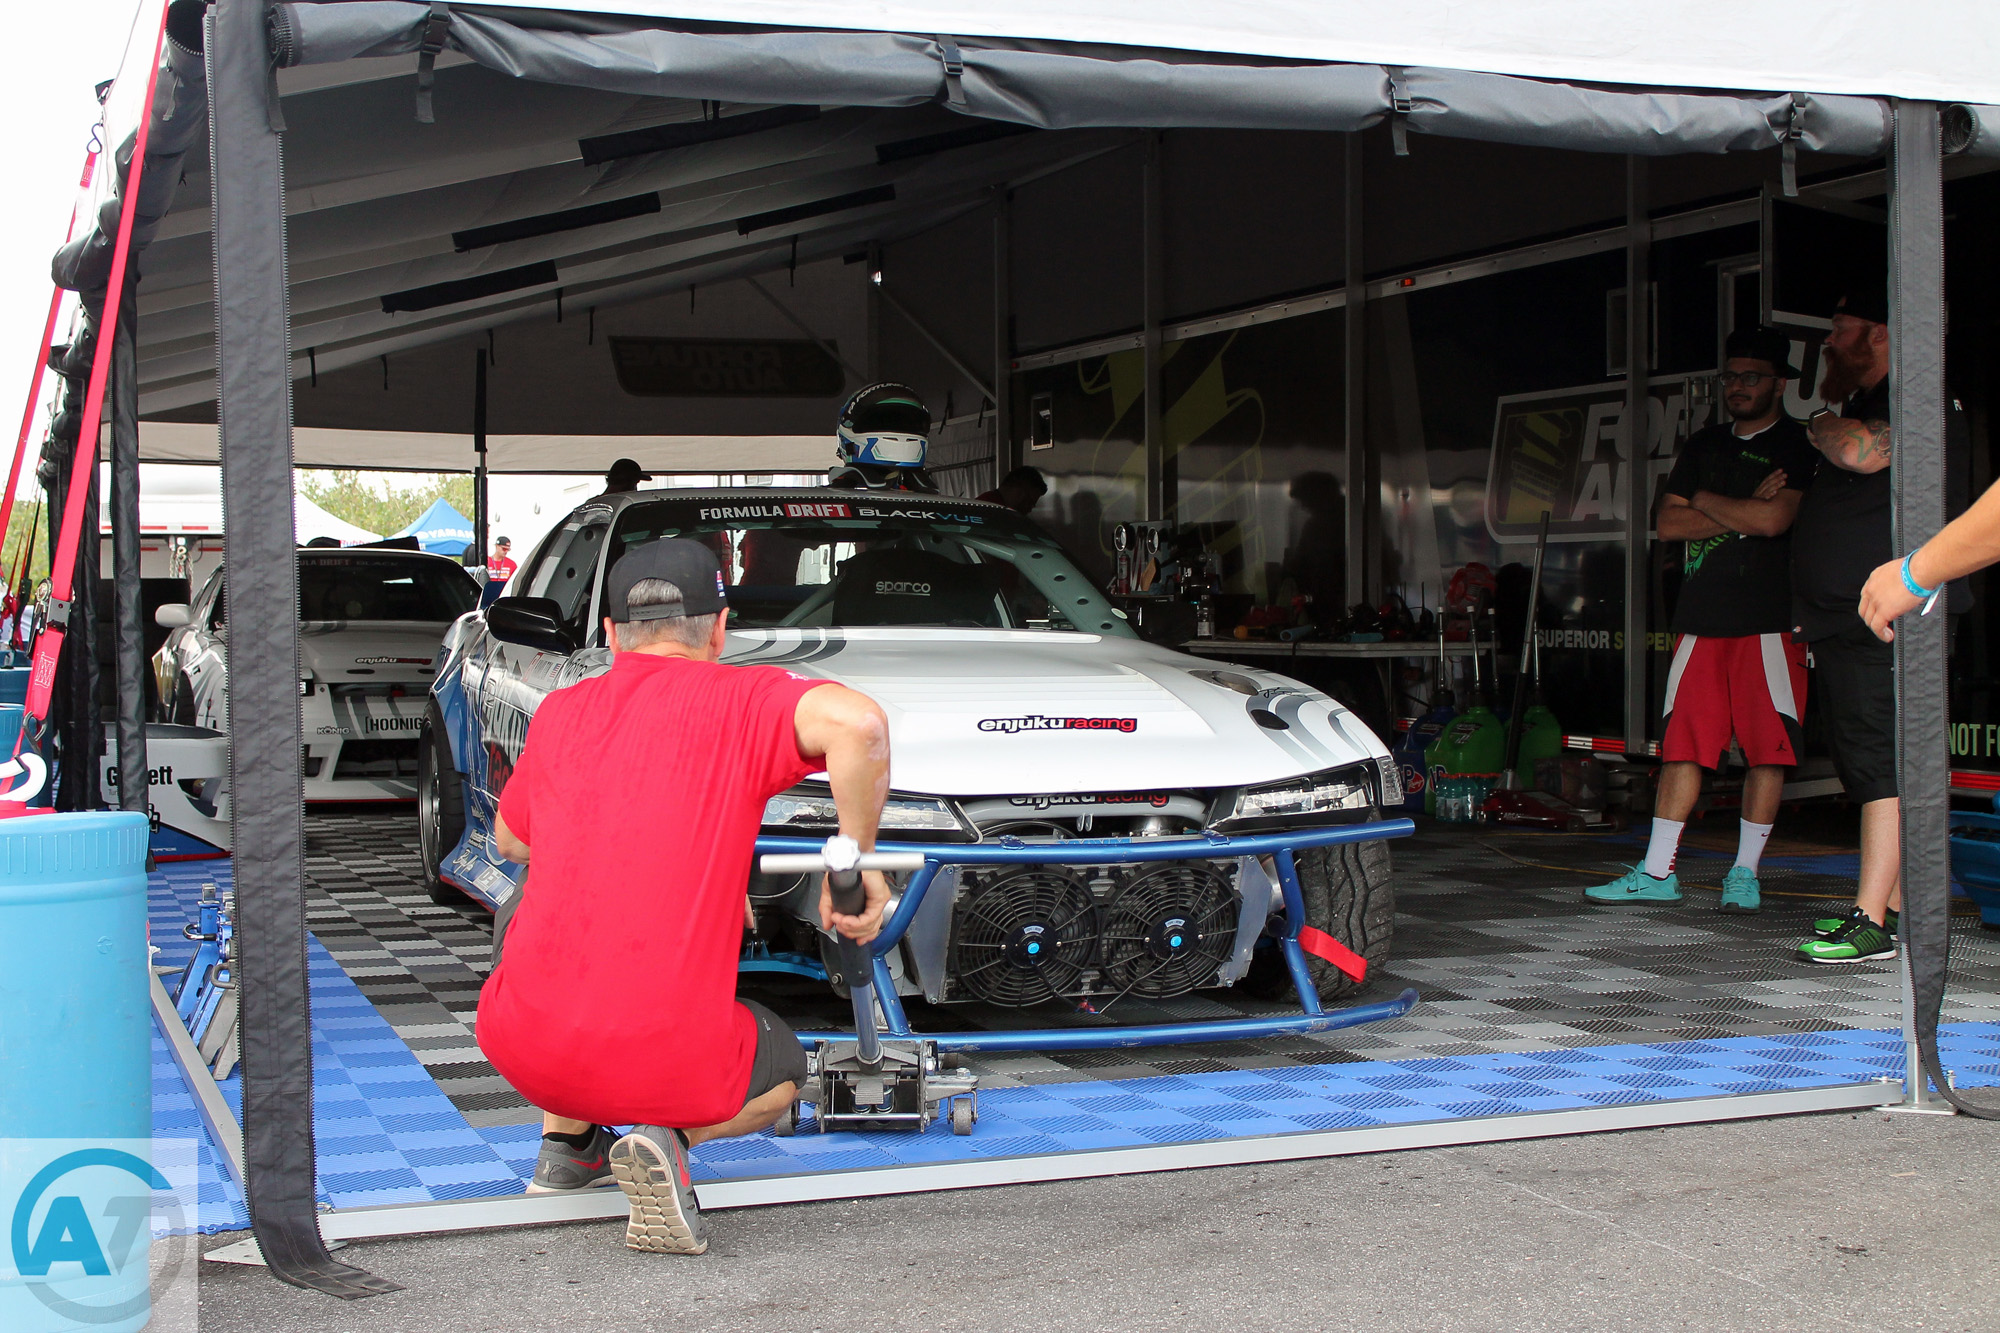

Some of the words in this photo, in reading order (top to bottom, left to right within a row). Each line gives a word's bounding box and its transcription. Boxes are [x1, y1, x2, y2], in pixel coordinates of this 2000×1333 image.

[700, 505, 784, 520] FORMULA
[789, 503, 846, 517] DRIFT
[859, 508, 984, 524] BLACKVUE
[429, 528, 475, 539] YAMAH
[875, 580, 931, 593] sparco
[1538, 629, 1610, 650] SUPERIOR
[106, 766, 173, 787] Gett
